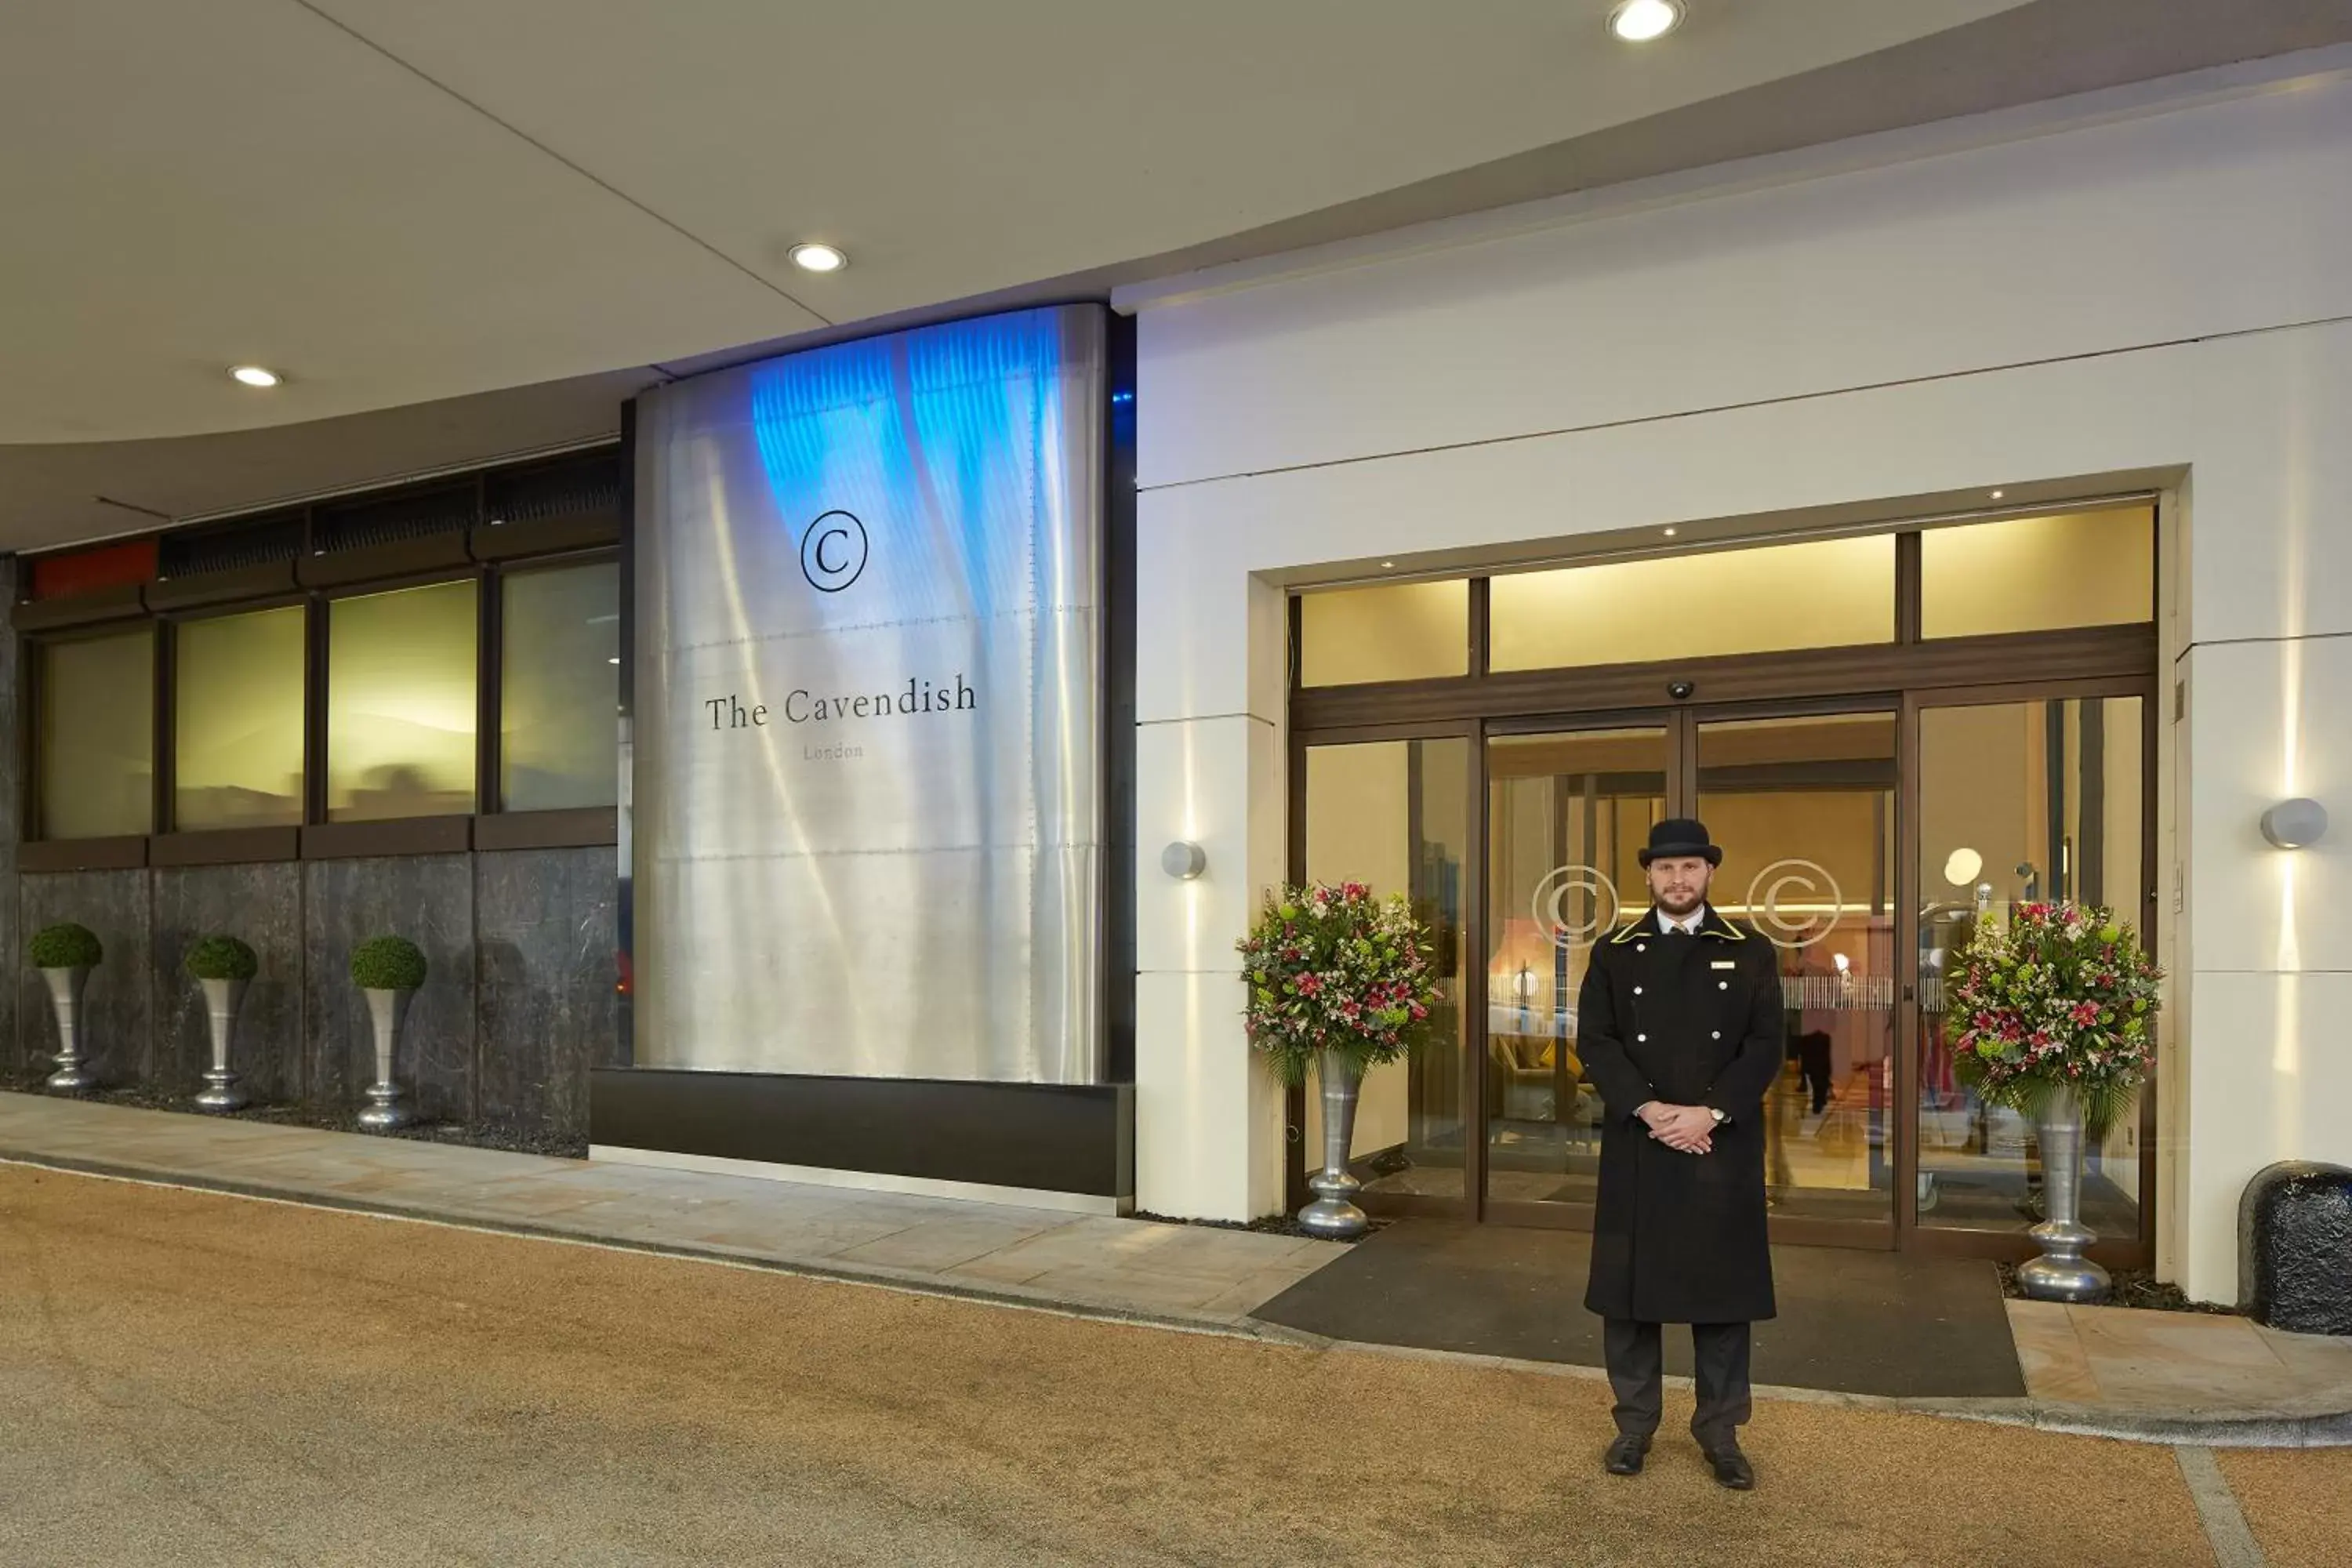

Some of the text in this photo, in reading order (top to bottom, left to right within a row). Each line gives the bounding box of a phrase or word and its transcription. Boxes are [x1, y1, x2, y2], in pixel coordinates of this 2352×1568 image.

[706, 673, 977, 730] The Cavendish
[804, 742, 864, 760] London
